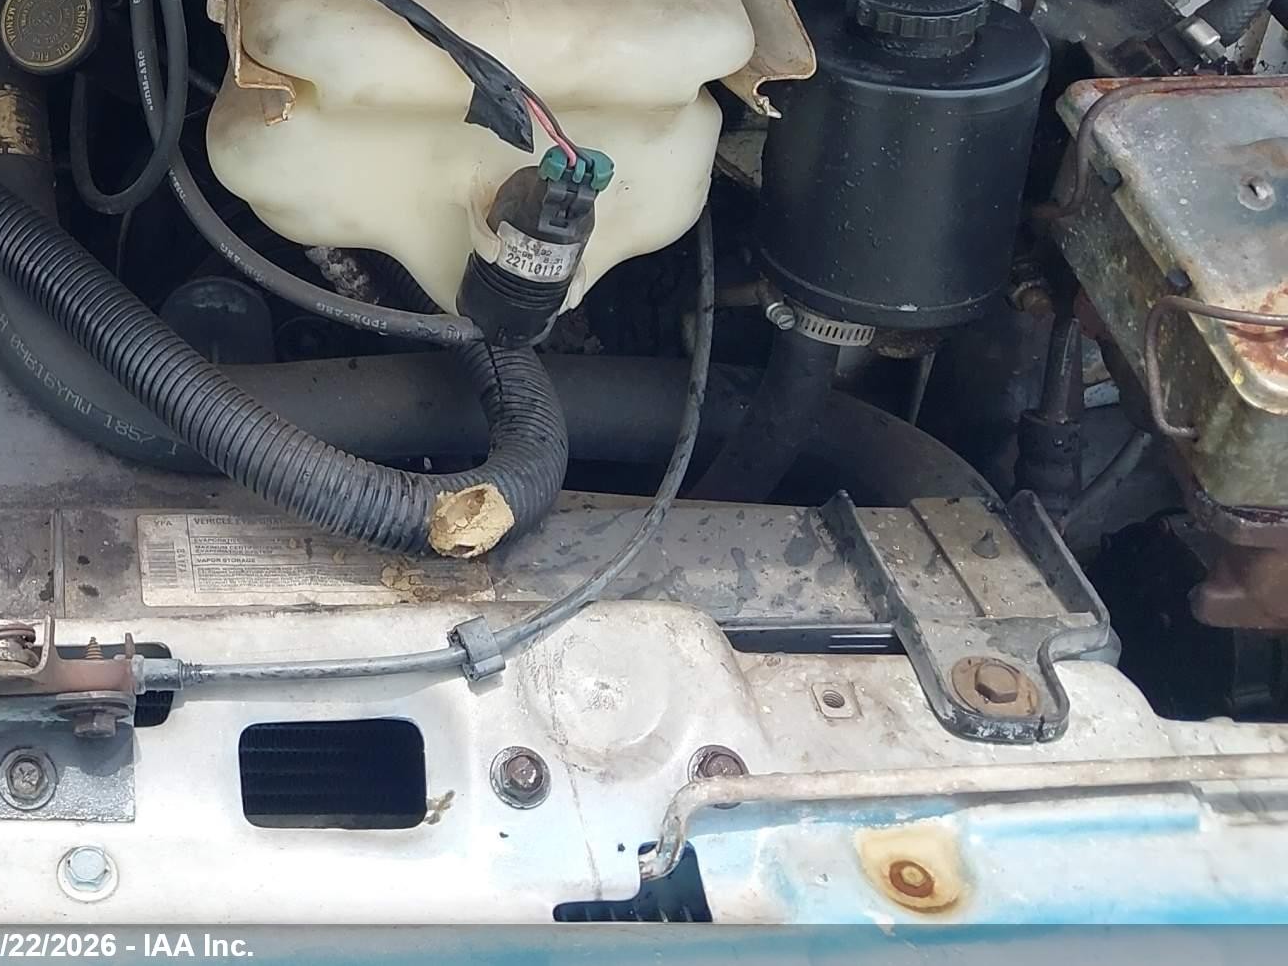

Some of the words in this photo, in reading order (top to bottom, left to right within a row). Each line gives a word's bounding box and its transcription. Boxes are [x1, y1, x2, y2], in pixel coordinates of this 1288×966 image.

[4, 6, 18, 47] MANUAL
[72, 3, 87, 41] ENGINE
[56, 41, 71, 56] OIL
[505, 252, 563, 276] 22110112
